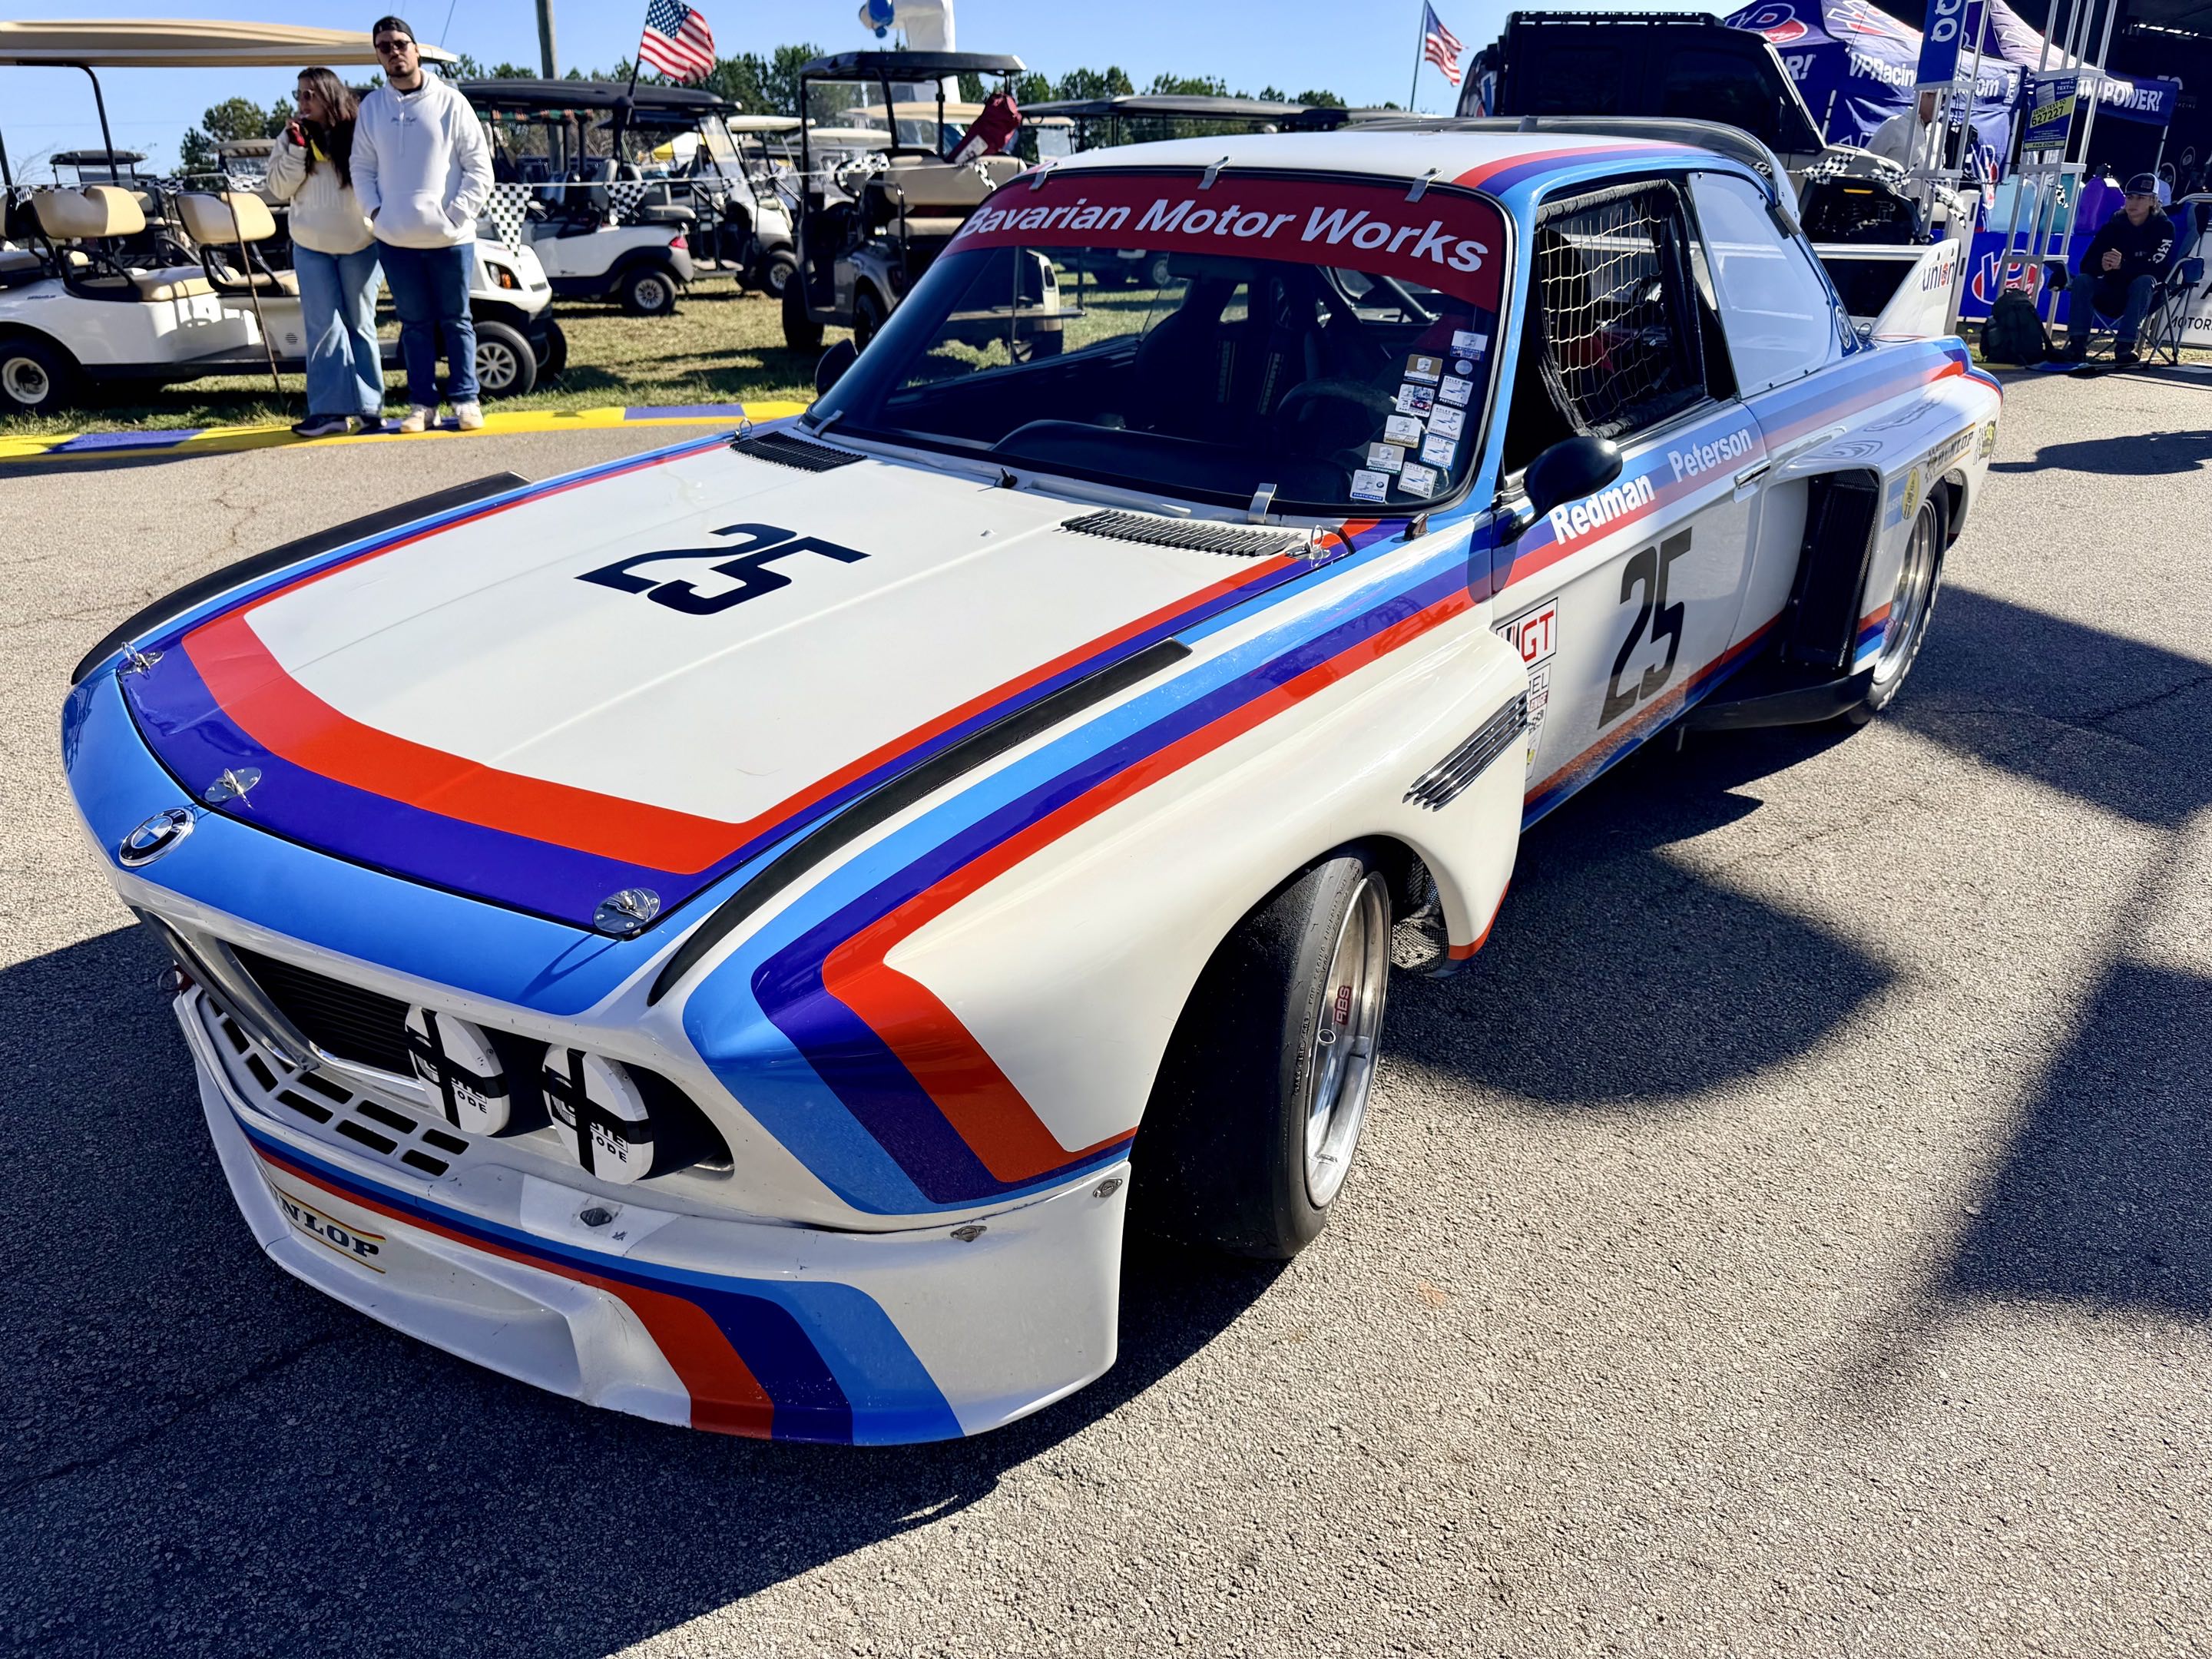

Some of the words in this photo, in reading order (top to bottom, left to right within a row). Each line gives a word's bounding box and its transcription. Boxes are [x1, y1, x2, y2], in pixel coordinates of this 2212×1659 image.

[2032, 105, 2064, 126] 627227
[2046, 101, 2058, 110] TEXT
[2101, 82, 2164, 112] POWER!
[956, 198, 1131, 240] Bavarian
[1135, 199, 1296, 239] Motor
[1302, 206, 1488, 273] Works
[1937, 432, 1973, 466] DUNLOP
[1548, 475, 1656, 545] Redman
[1667, 428, 1753, 483] Peterson
[574, 523, 873, 615] 25
[1522, 610, 1554, 663] GT
[1598, 526, 1692, 730] 25
[270, 1187, 379, 1258] NLOP
